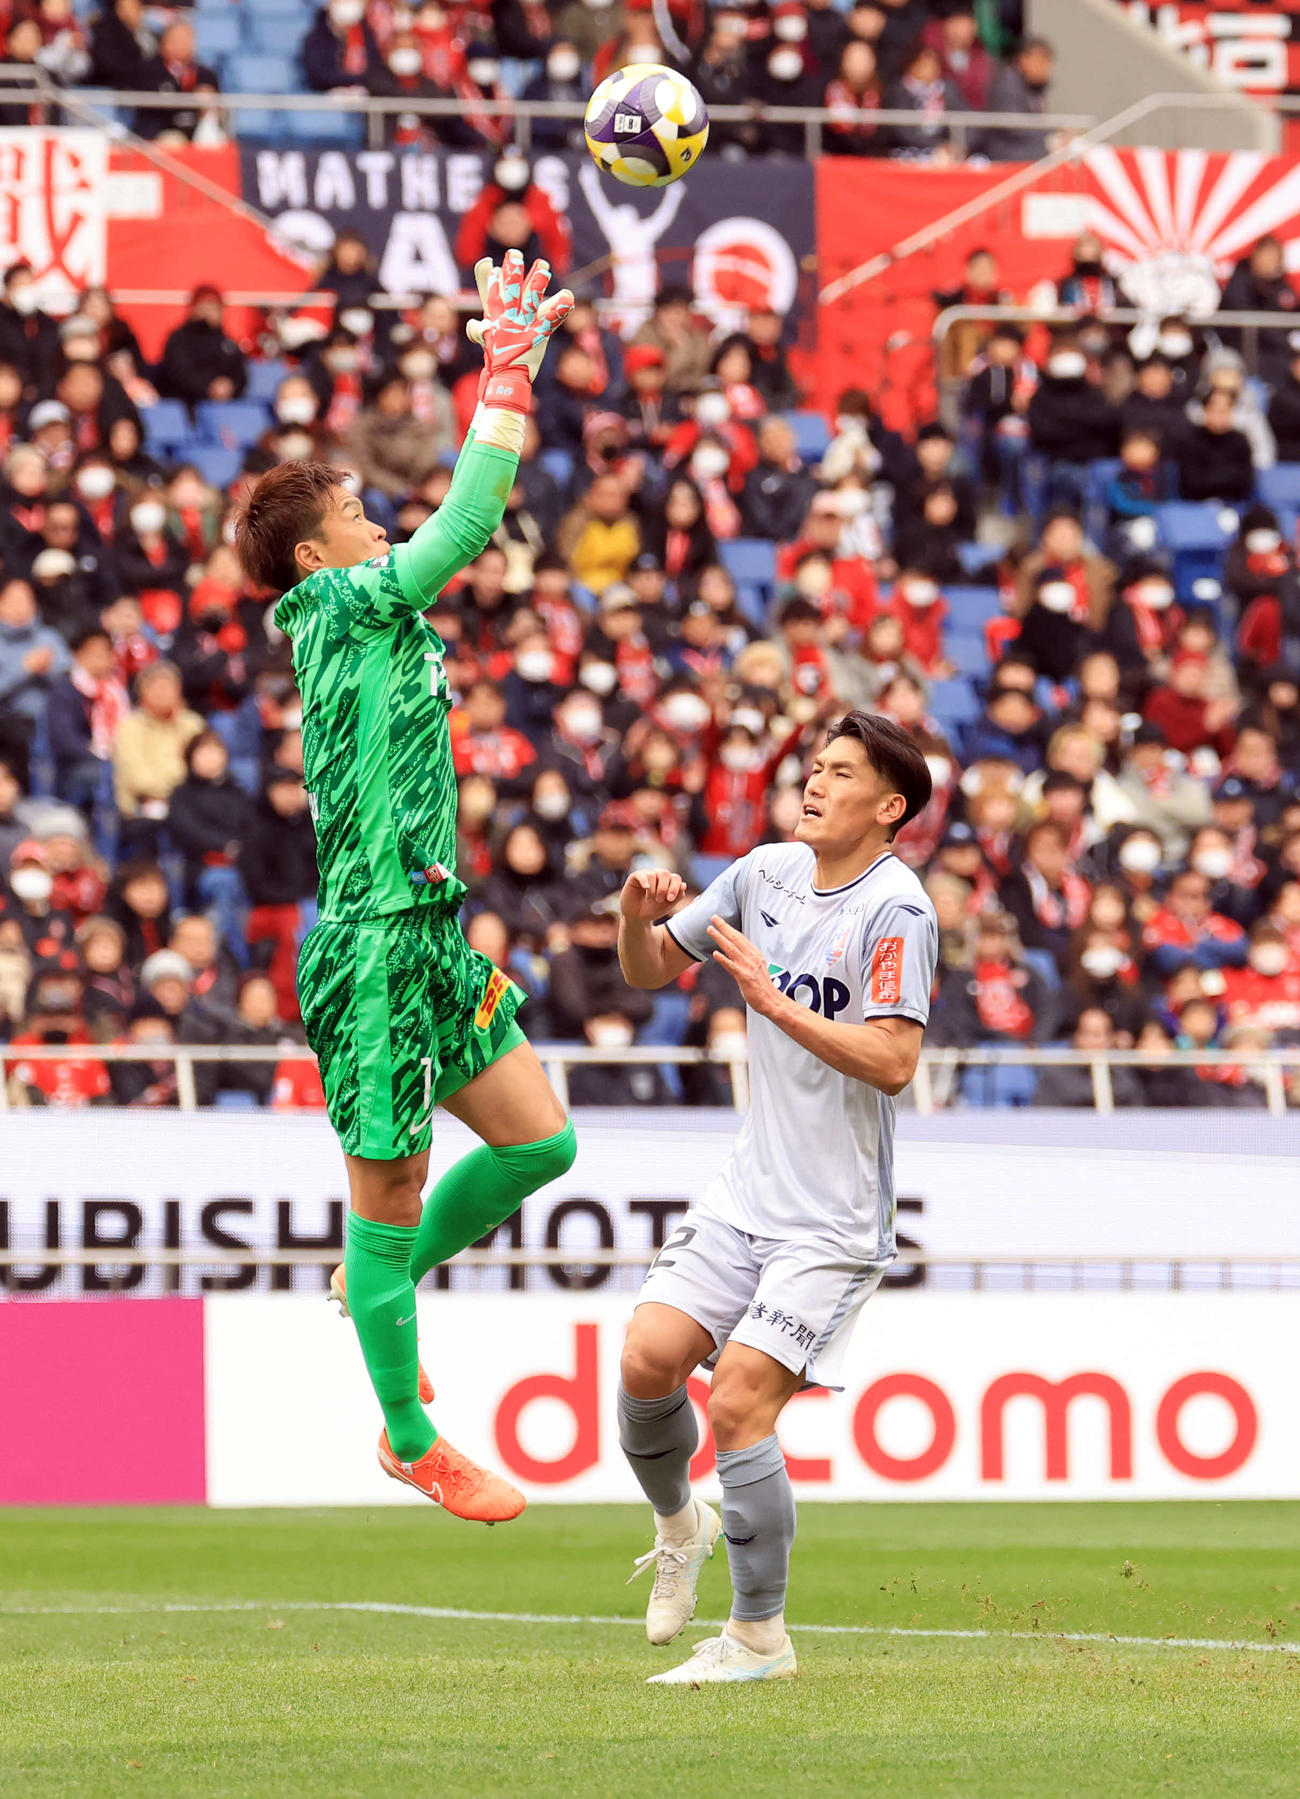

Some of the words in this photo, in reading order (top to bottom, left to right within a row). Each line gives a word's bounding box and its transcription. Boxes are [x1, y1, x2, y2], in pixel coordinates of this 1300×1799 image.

[256, 150, 570, 213] MATHES
[877, 940, 898, 1000] おかやま信金
[420, 1056, 433, 1112] 1
[0, 1199, 346, 1291] UBISH
[495, 1323, 1259, 1482] domo
